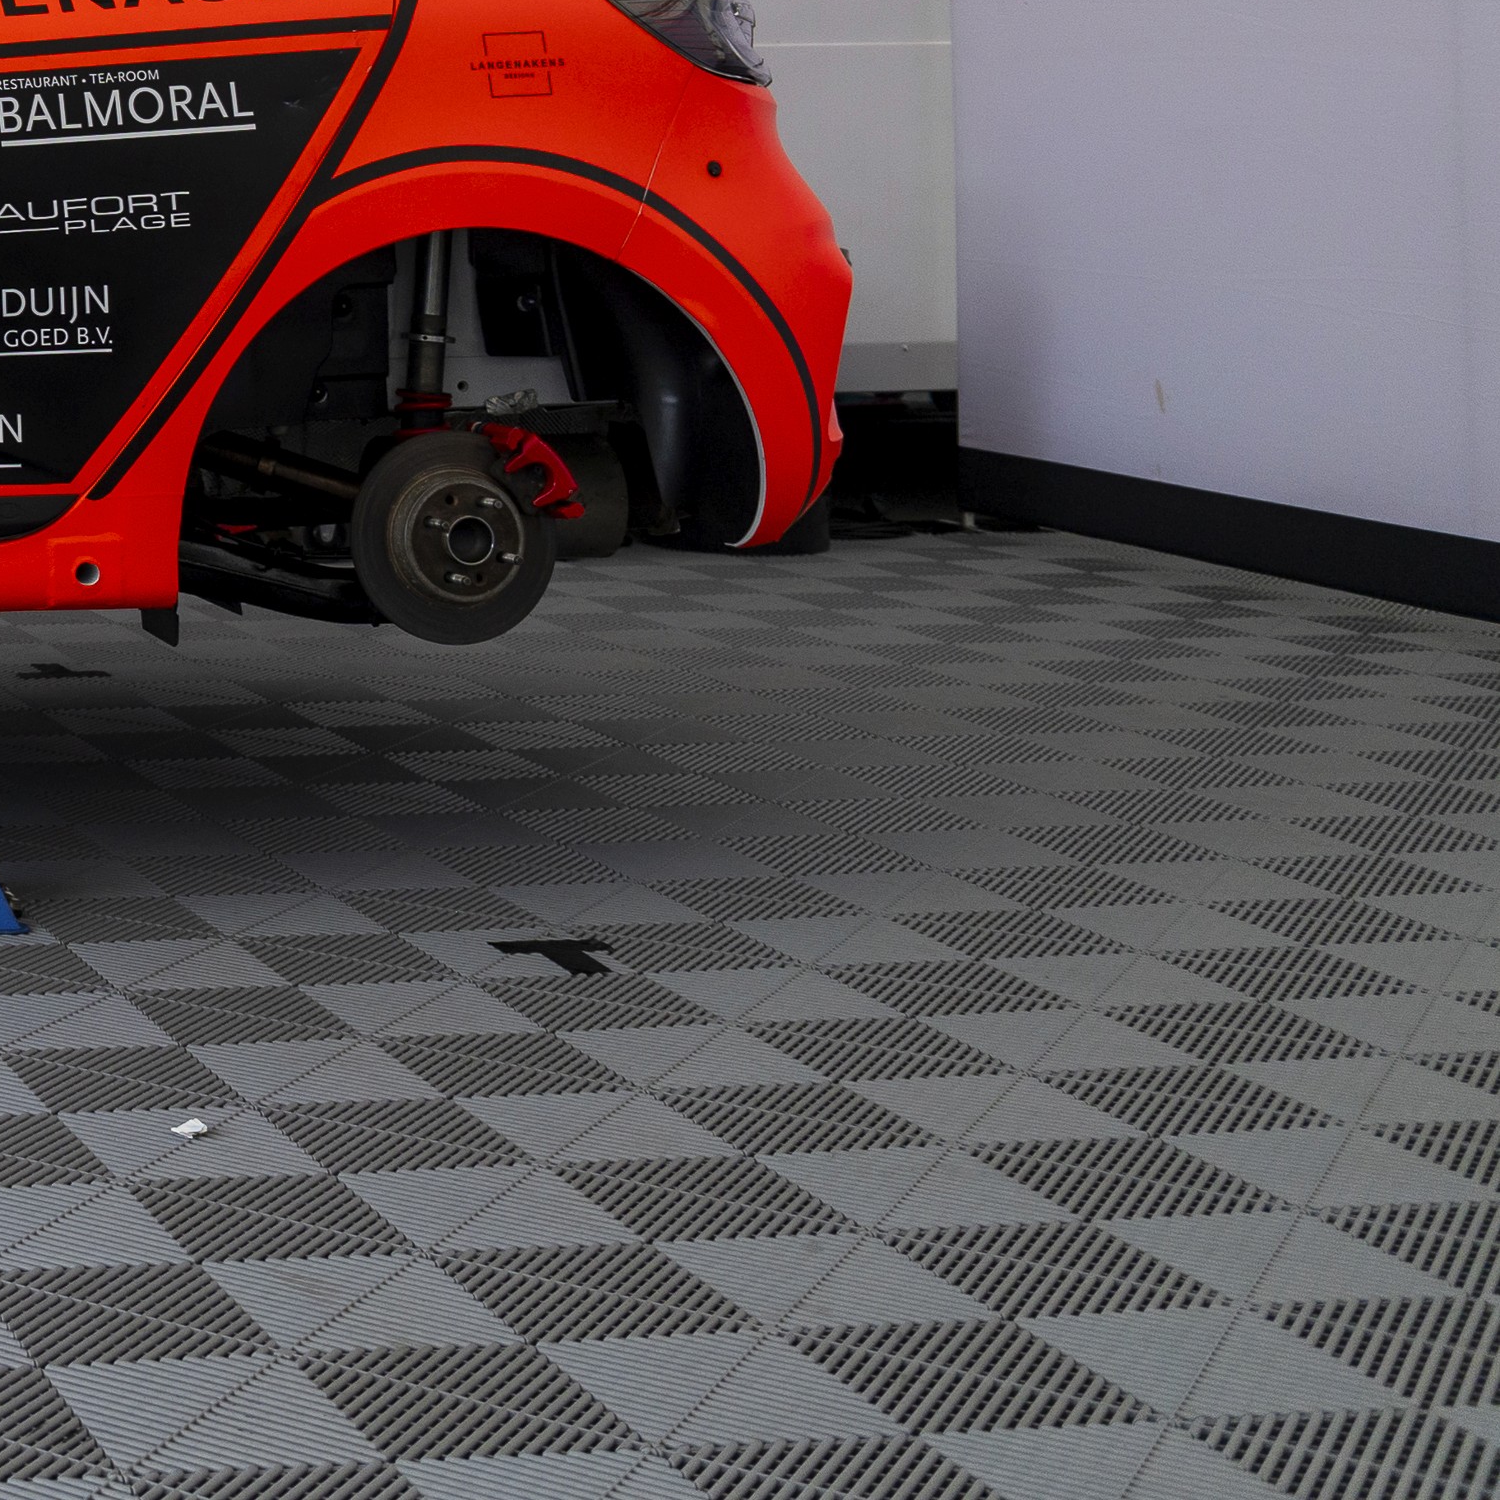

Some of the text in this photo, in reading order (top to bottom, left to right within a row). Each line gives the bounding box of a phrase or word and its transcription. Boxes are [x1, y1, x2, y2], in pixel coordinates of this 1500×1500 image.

[89, 69, 160, 85] TEA-ROOM
[64, 211, 191, 235] PLAGE
[4, 327, 69, 349] GOED
[77, 326, 113, 346] B.V.
